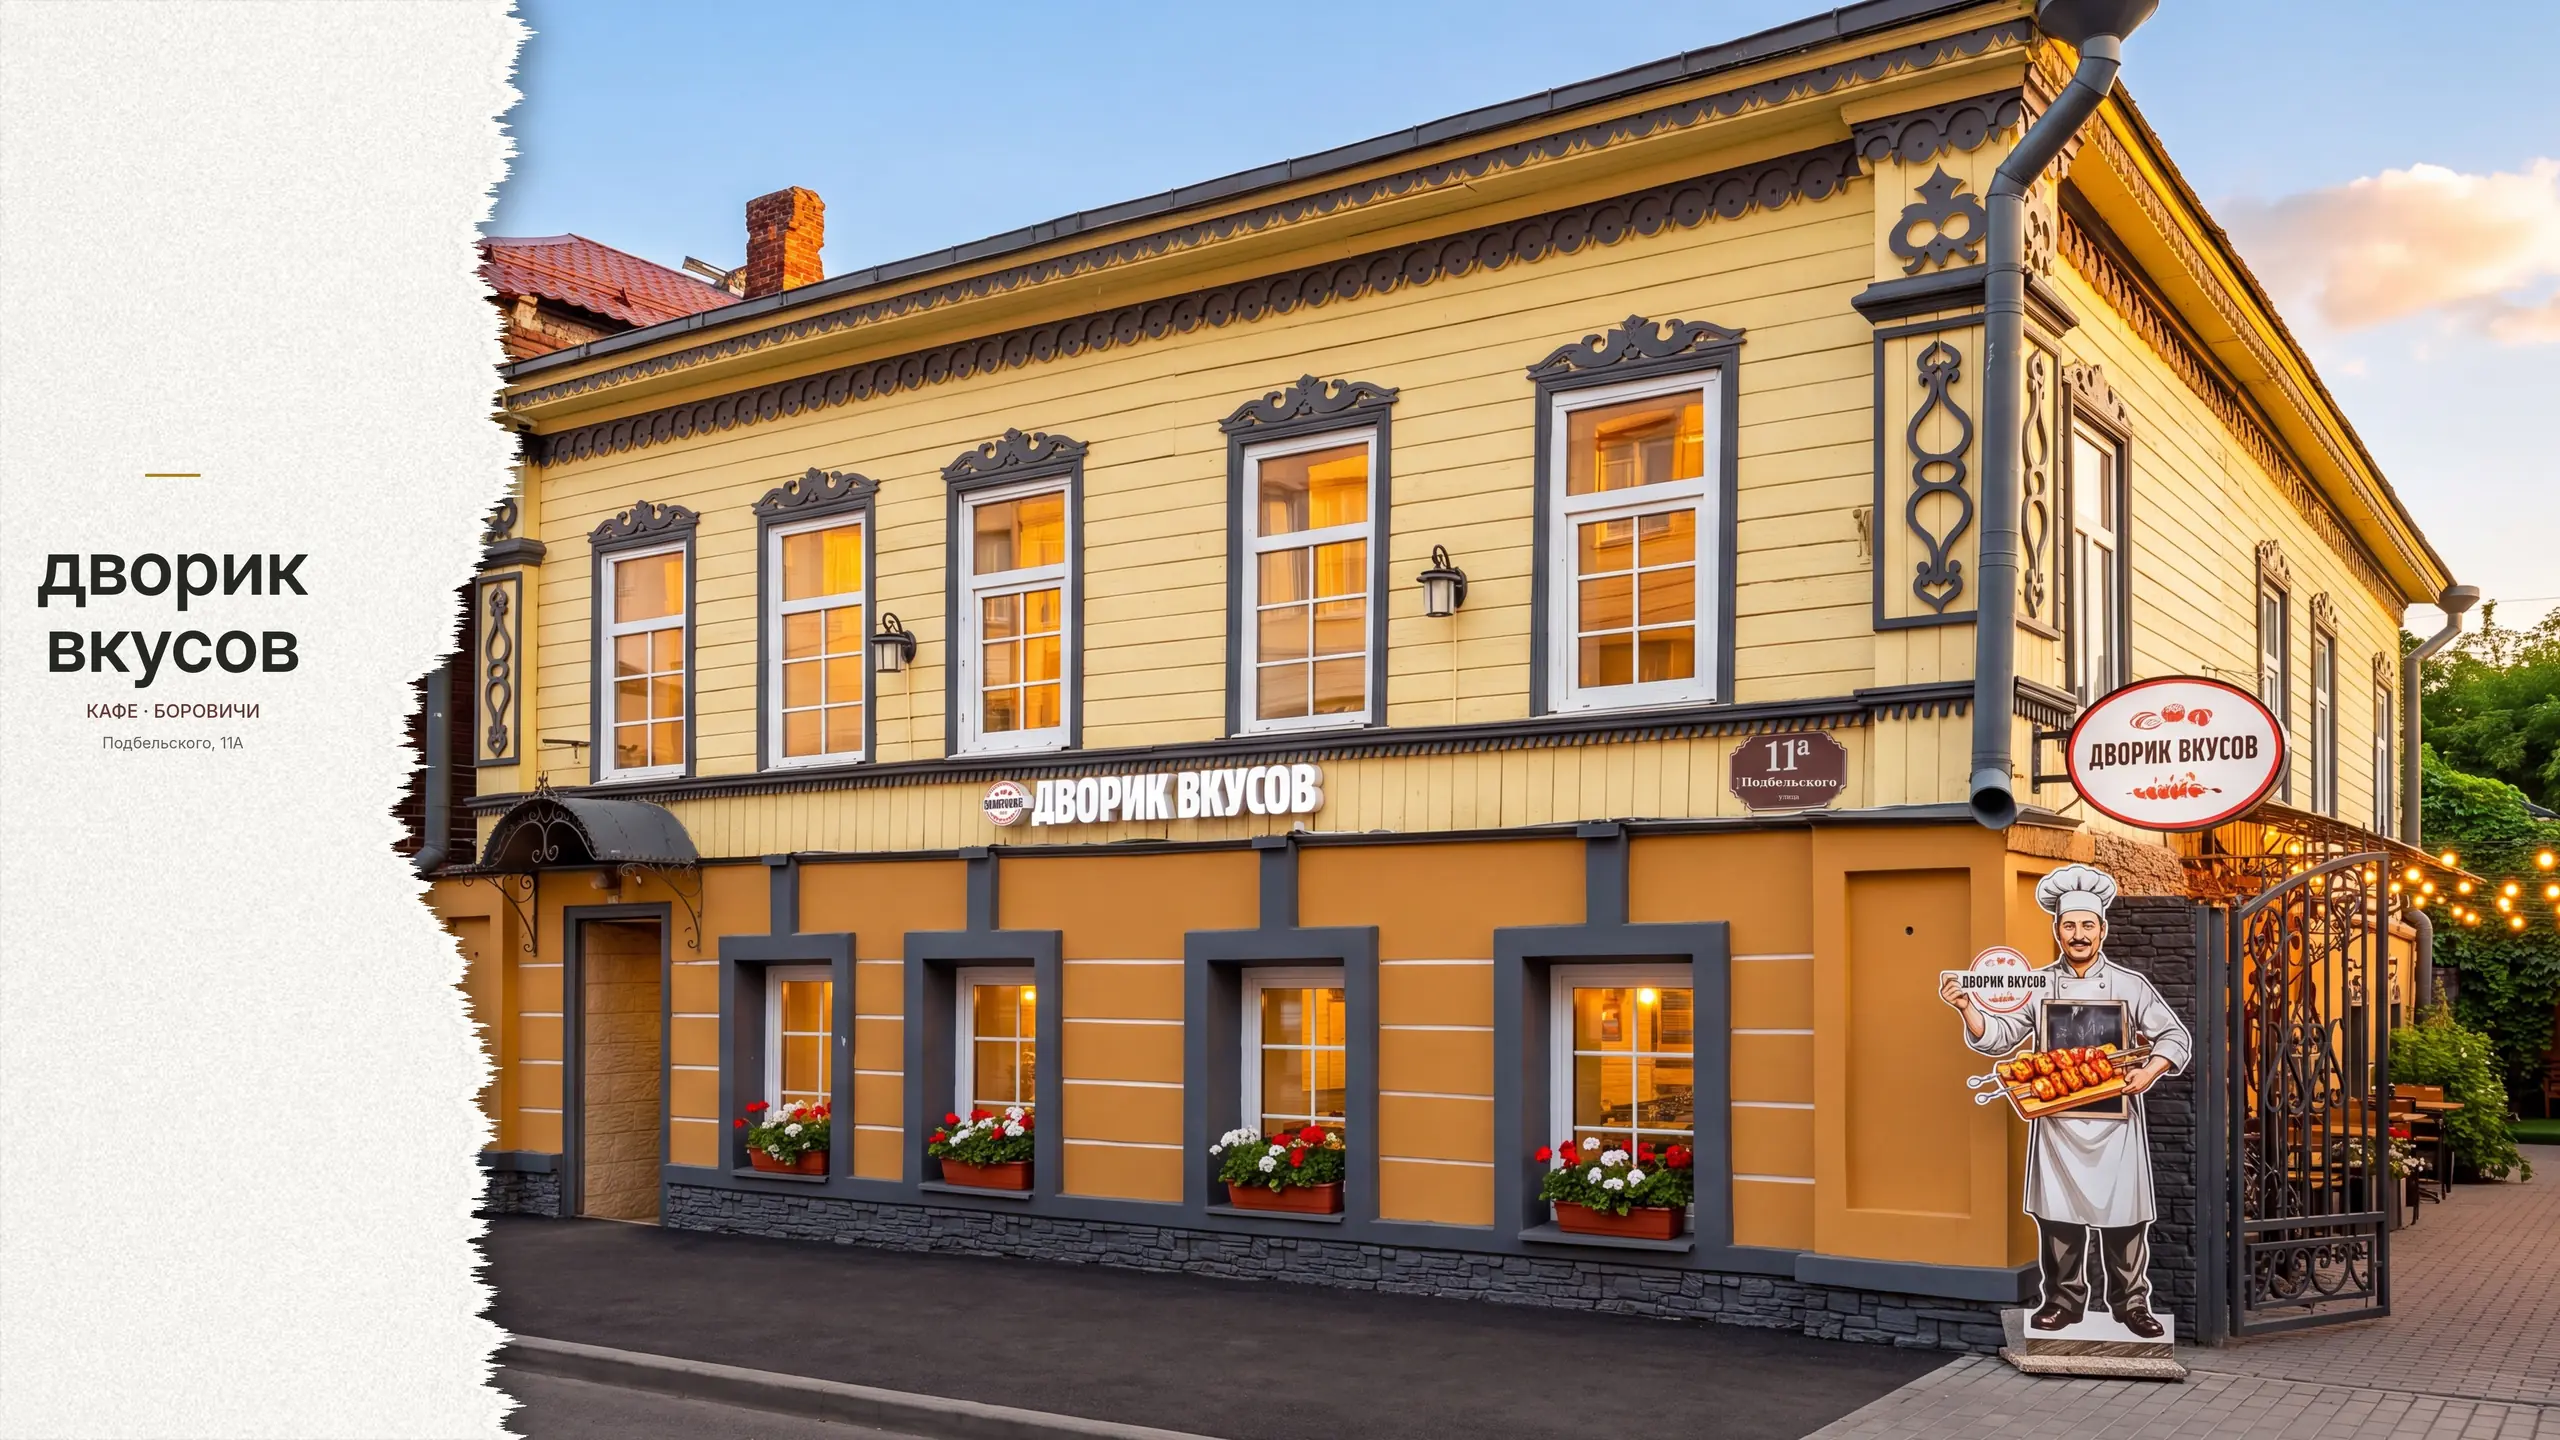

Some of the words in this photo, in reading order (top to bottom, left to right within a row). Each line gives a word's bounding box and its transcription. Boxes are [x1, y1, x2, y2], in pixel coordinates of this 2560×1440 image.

[2089, 740, 2172, 771] ДВОРИК
[2178, 735, 2258, 763] ВКУСОВ
[1031, 774, 1175, 826] ДВОРИК
[1177, 763, 1322, 819] ВКУСОВ
[1741, 777, 1837, 788] Подбельского
[1961, 975, 2004, 988] ДВОРИК
[2007, 975, 2046, 988] ВКУСОВ
